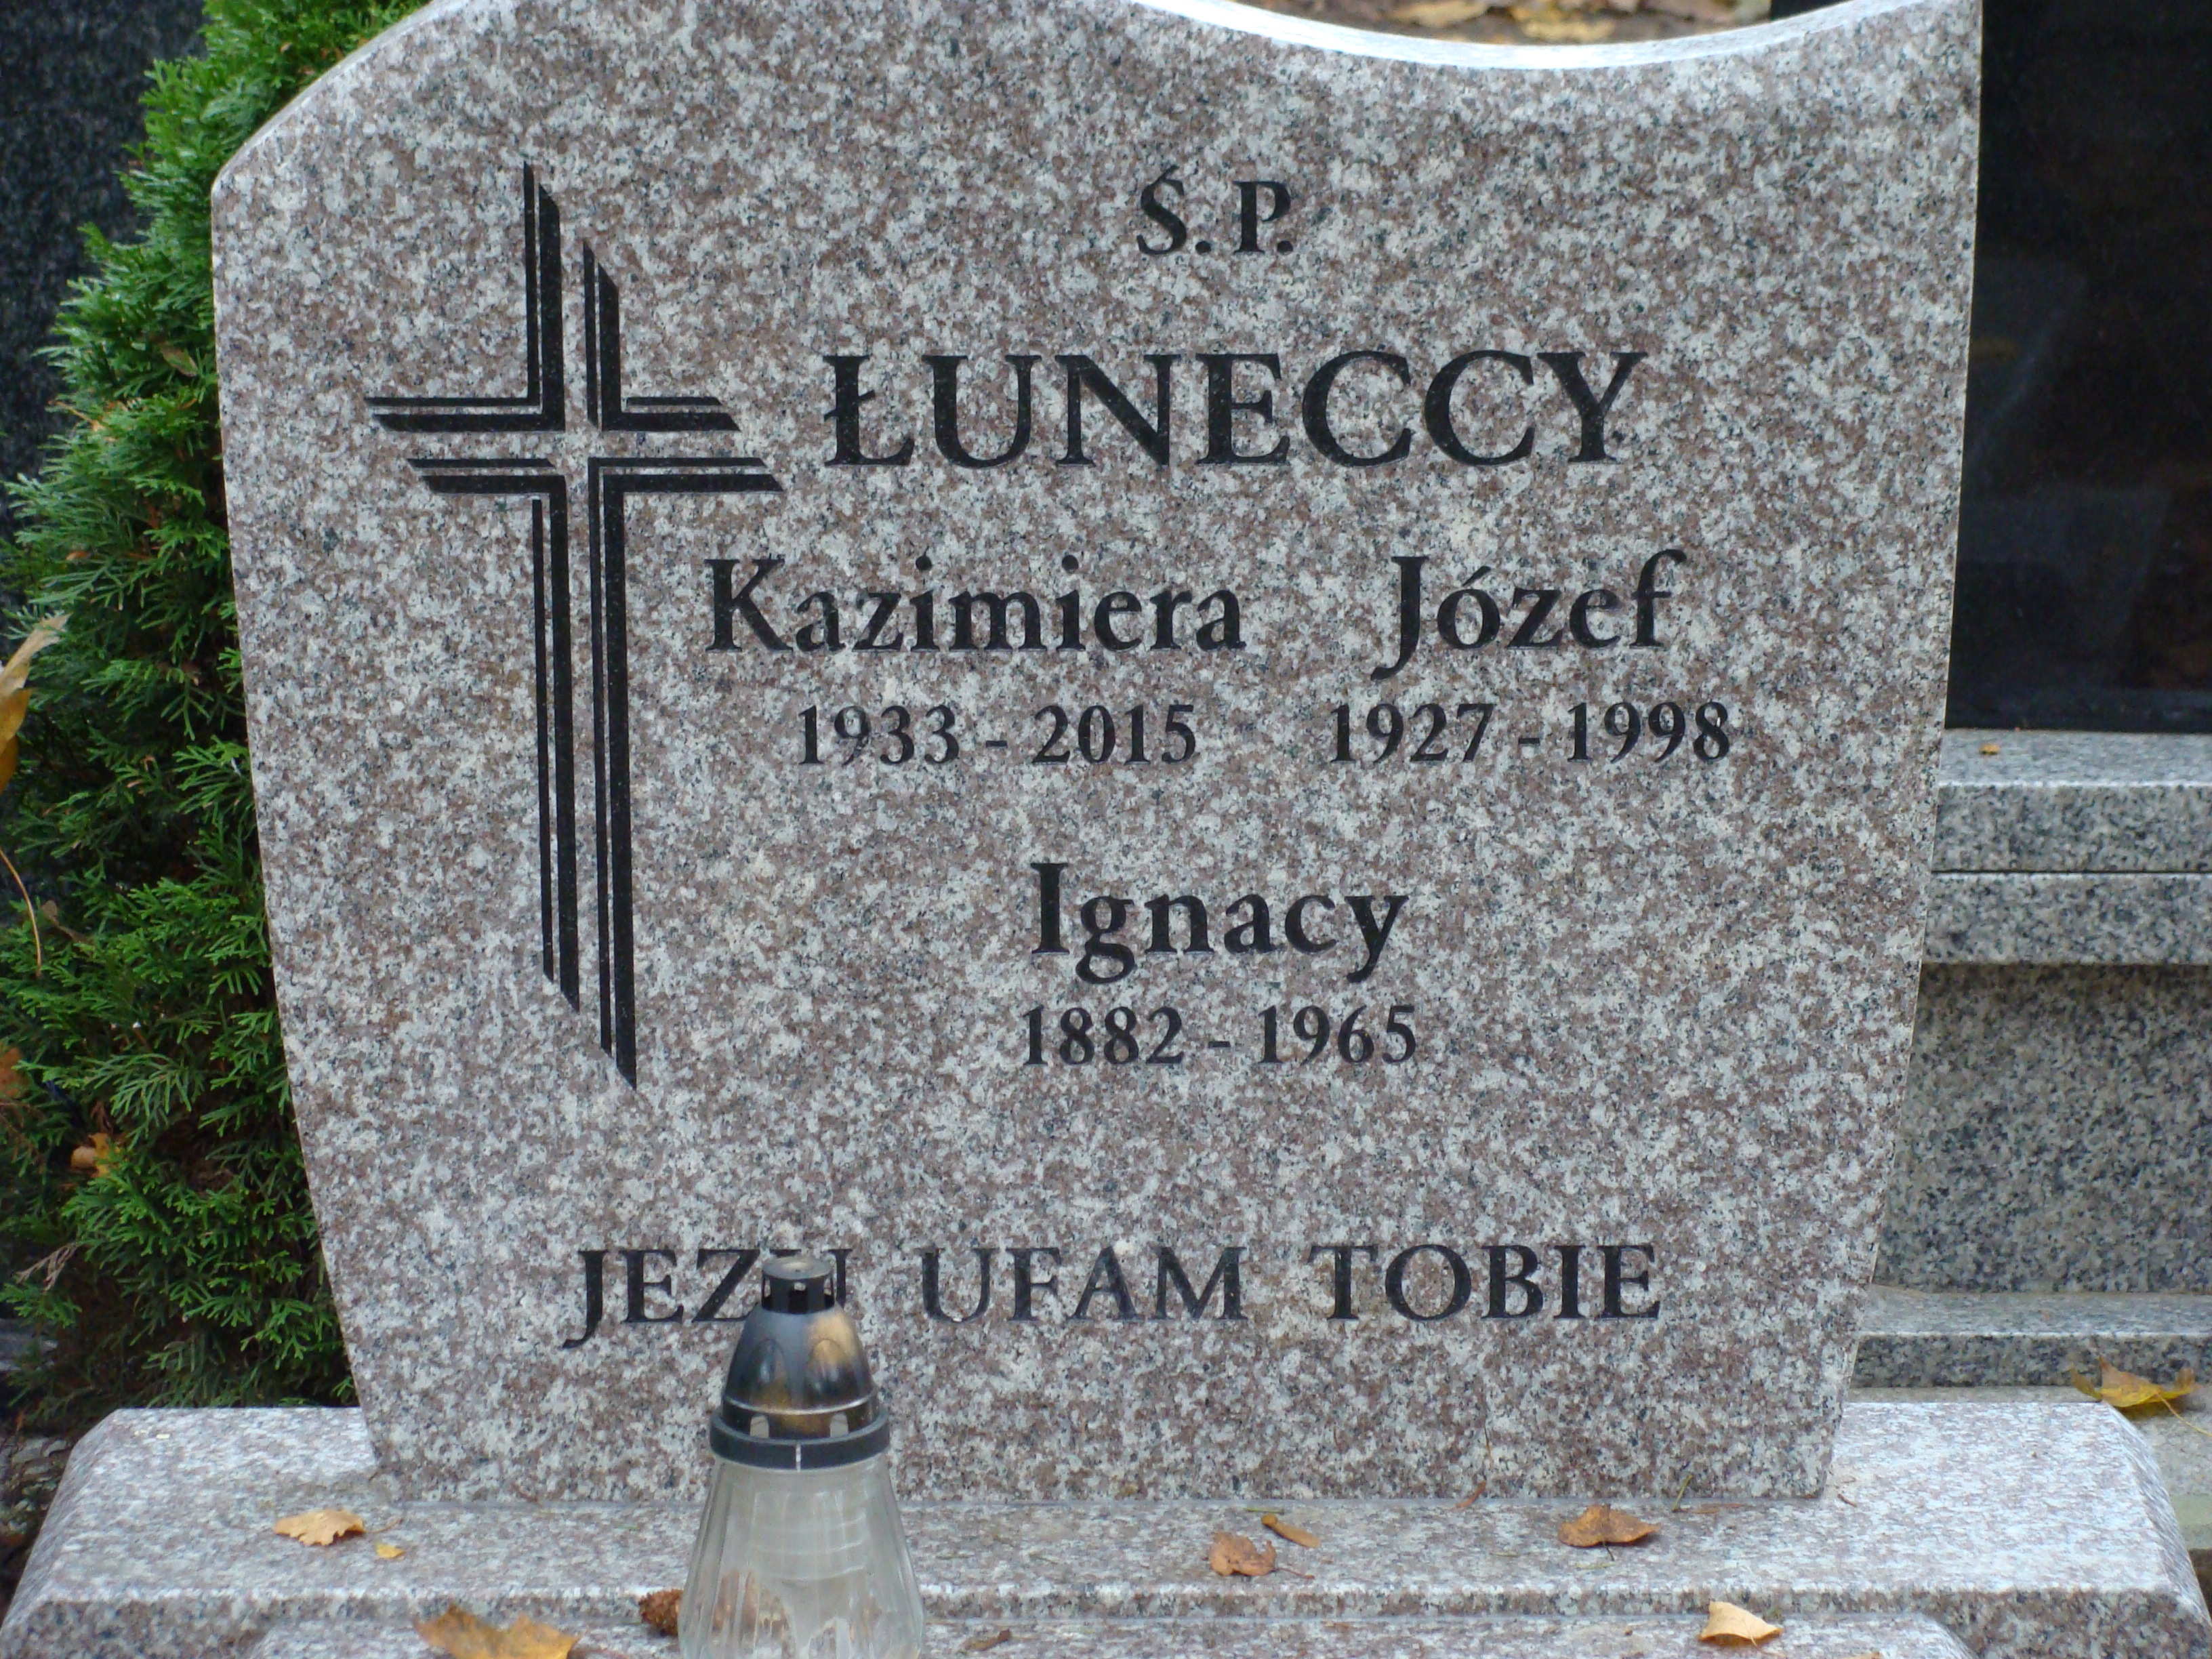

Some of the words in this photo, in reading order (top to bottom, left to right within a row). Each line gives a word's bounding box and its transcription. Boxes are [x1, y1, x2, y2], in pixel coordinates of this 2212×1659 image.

[823, 350, 1648, 470] ŁUNECCY
[703, 553, 1247, 653] Kazimiera
[1370, 549, 1687, 680] Józef
[1030, 862, 1410, 985] Ignacy
[914, 1246, 1248, 1323] UFAM
[1309, 1244, 1660, 1321] TOBIE
